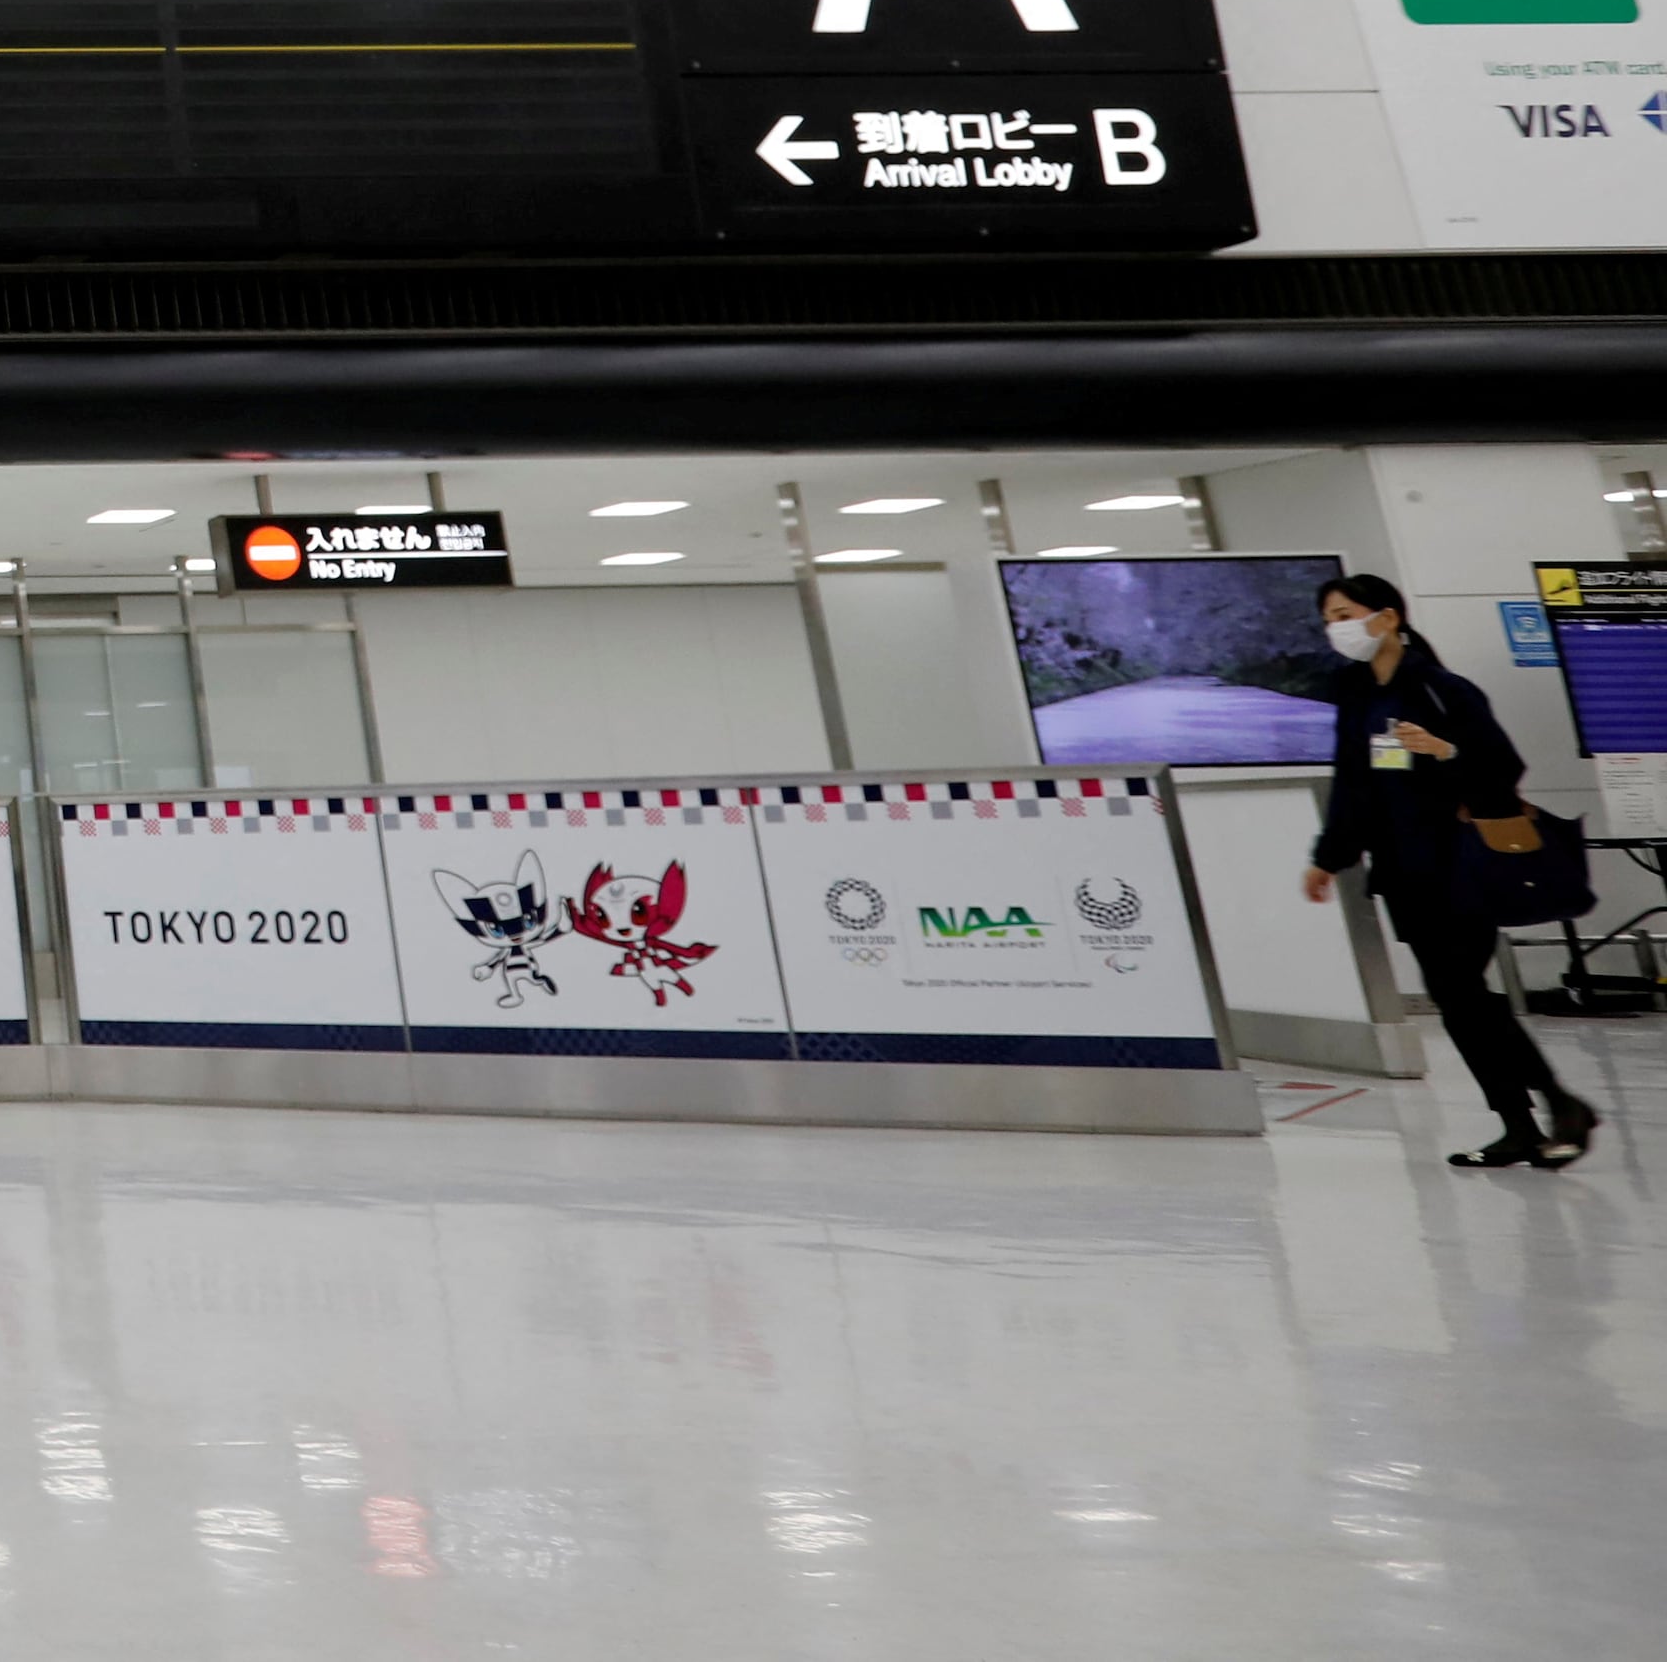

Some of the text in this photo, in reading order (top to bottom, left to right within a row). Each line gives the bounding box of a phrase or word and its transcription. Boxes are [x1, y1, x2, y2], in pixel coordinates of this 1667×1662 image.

[853, 110, 1077, 154] 到着ロビー
[1499, 105, 1610, 137] VISA
[1093, 109, 1166, 185] B
[864, 157, 1073, 191] Arrival Lobby
[306, 526, 431, 551] 入れません
[308, 559, 396, 582] No Entry
[104, 911, 347, 944] TOKYO 2020
[918, 906, 1043, 937] NAA
